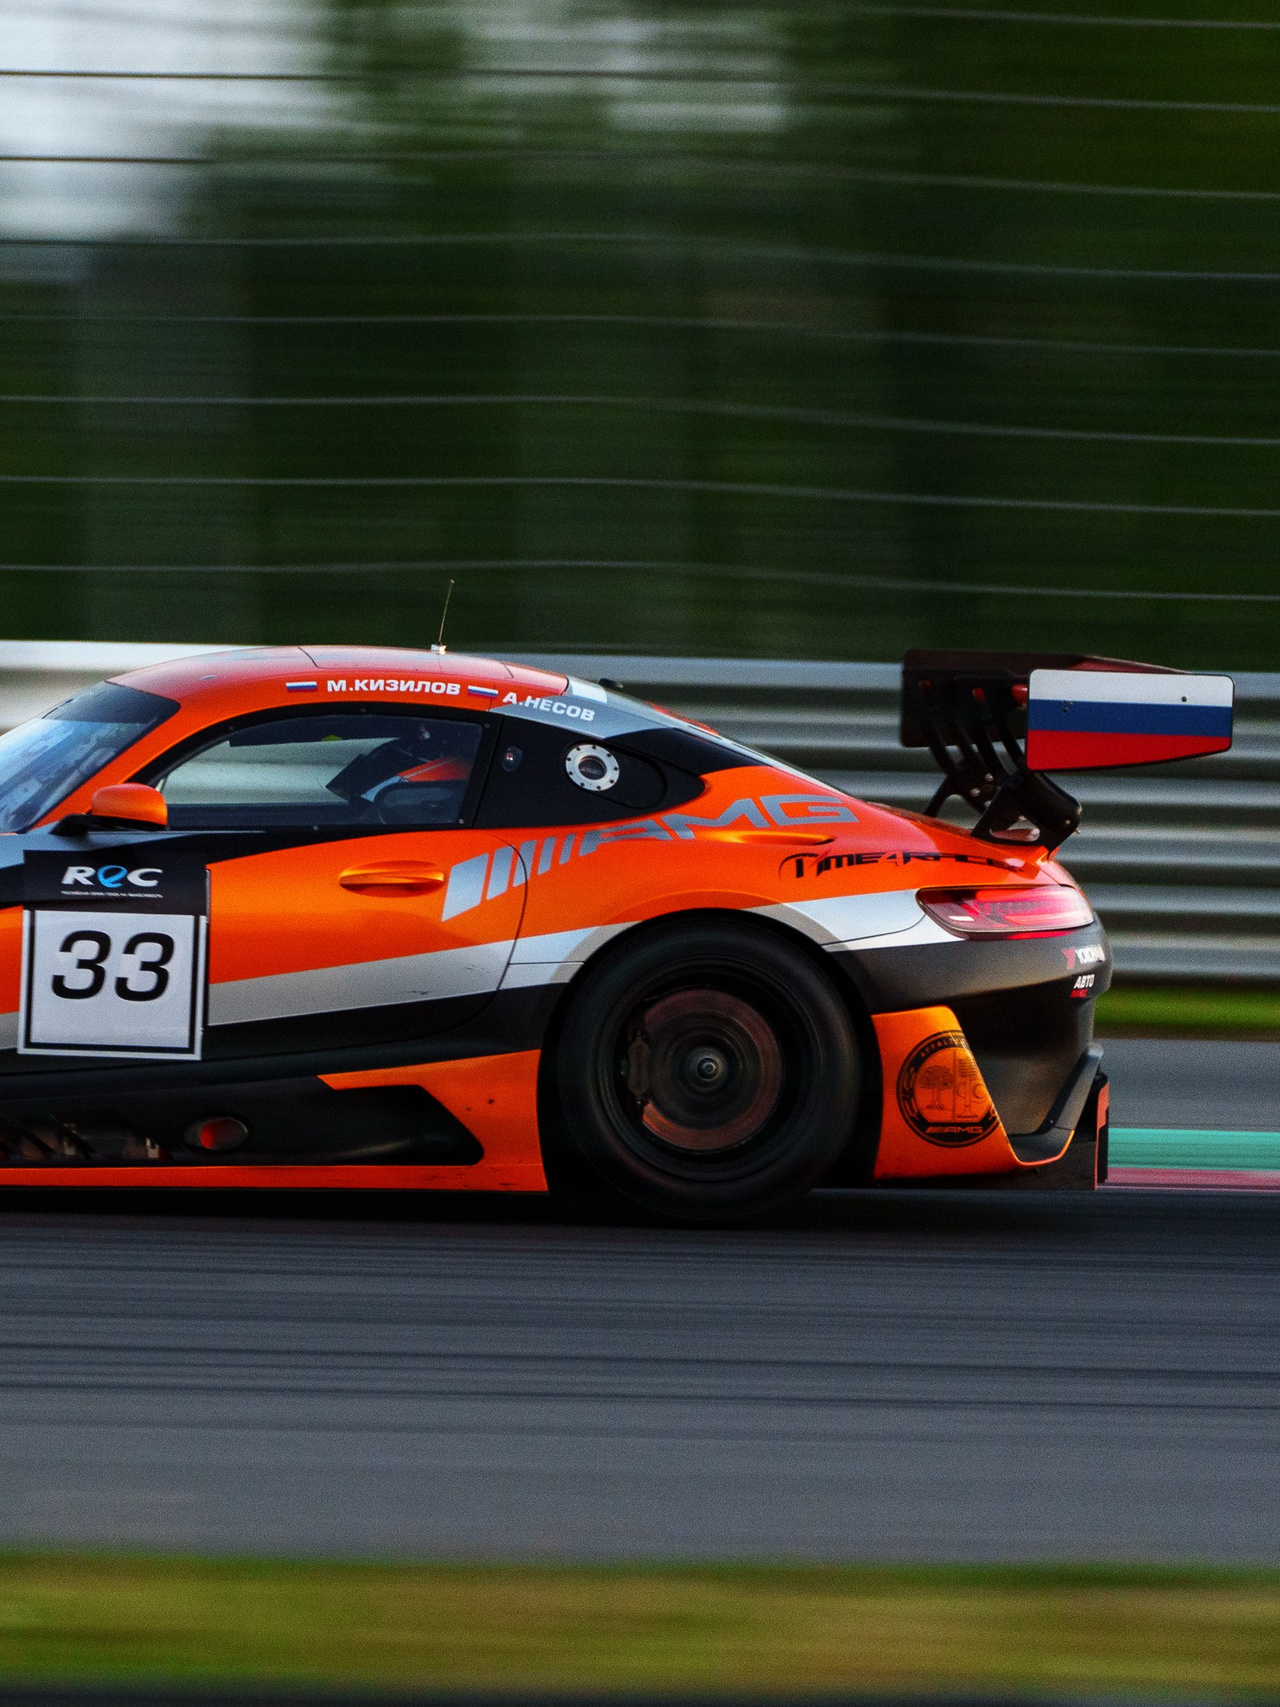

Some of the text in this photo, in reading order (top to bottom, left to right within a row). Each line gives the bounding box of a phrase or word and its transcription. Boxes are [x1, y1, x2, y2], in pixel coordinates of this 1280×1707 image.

[326, 679, 461, 696] М.КИЗИЛОВ
[502, 693, 595, 721] А.НЕСОВ
[50, 930, 175, 1002] 33
[1073, 973, 1095, 989] АВТО
